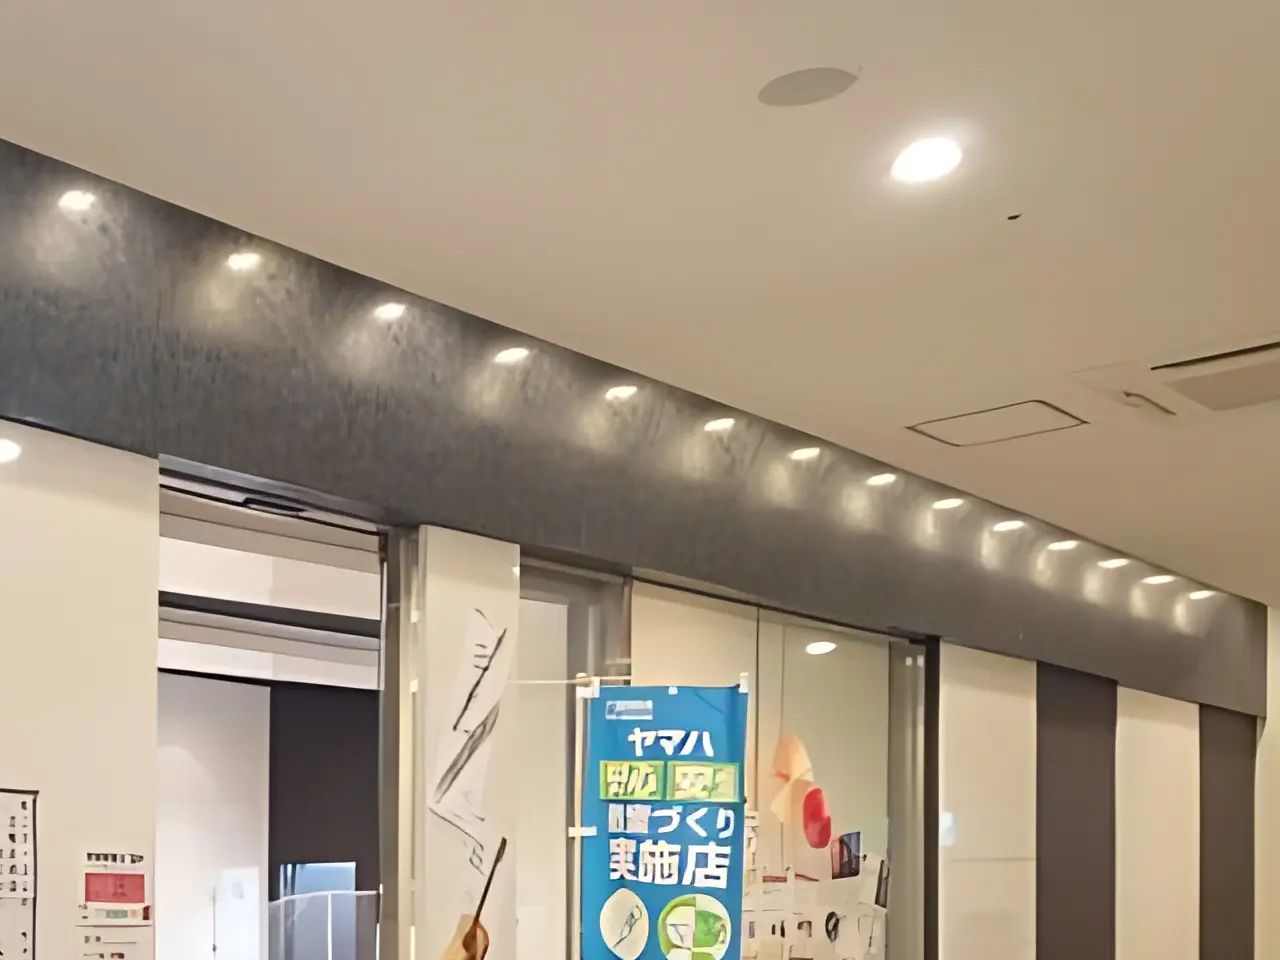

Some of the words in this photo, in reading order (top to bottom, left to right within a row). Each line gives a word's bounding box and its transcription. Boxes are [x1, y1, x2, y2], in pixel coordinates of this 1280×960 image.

[627, 726, 715, 758] ヤマハ
[608, 803, 736, 840] づくり
[609, 837, 732, 890] 実施店
